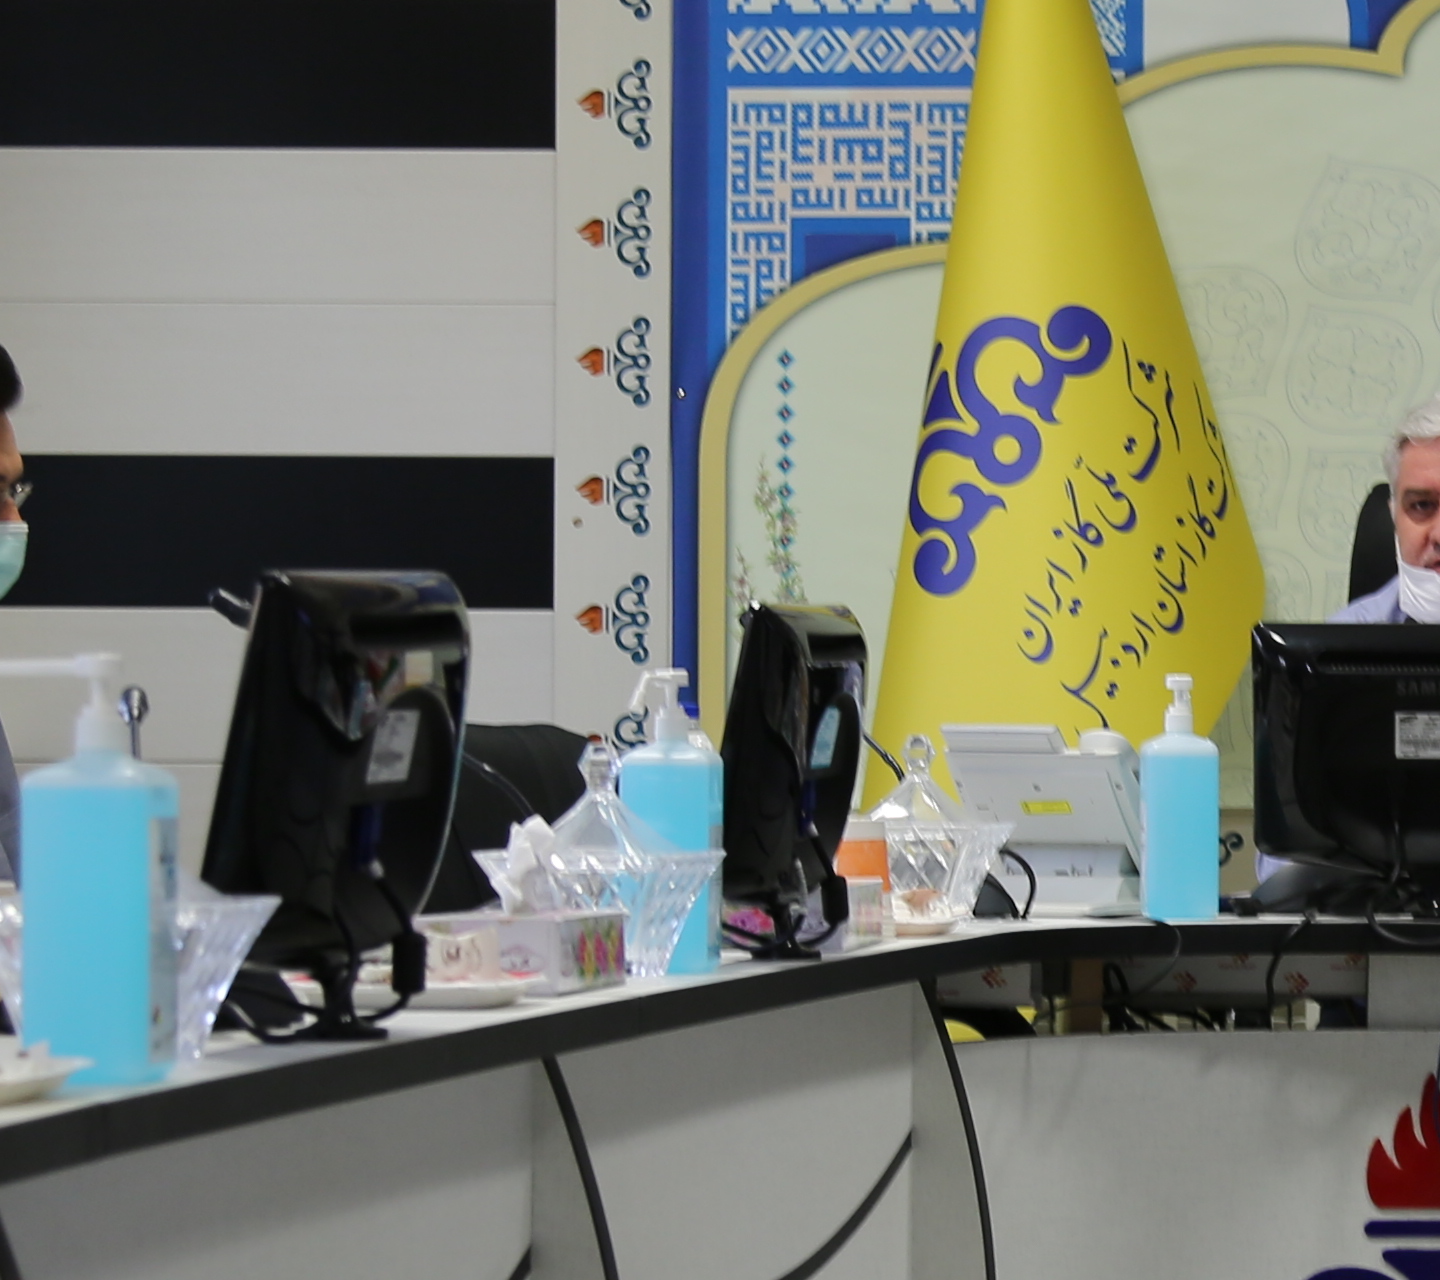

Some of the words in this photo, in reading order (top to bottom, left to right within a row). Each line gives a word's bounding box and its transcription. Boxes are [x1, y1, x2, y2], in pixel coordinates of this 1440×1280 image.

[1122, 337, 1182, 484] شرکت
[1052, 476, 1105, 574] گاز
[1016, 556, 1083, 664] ایران
[1152, 541, 1200, 635] استان
